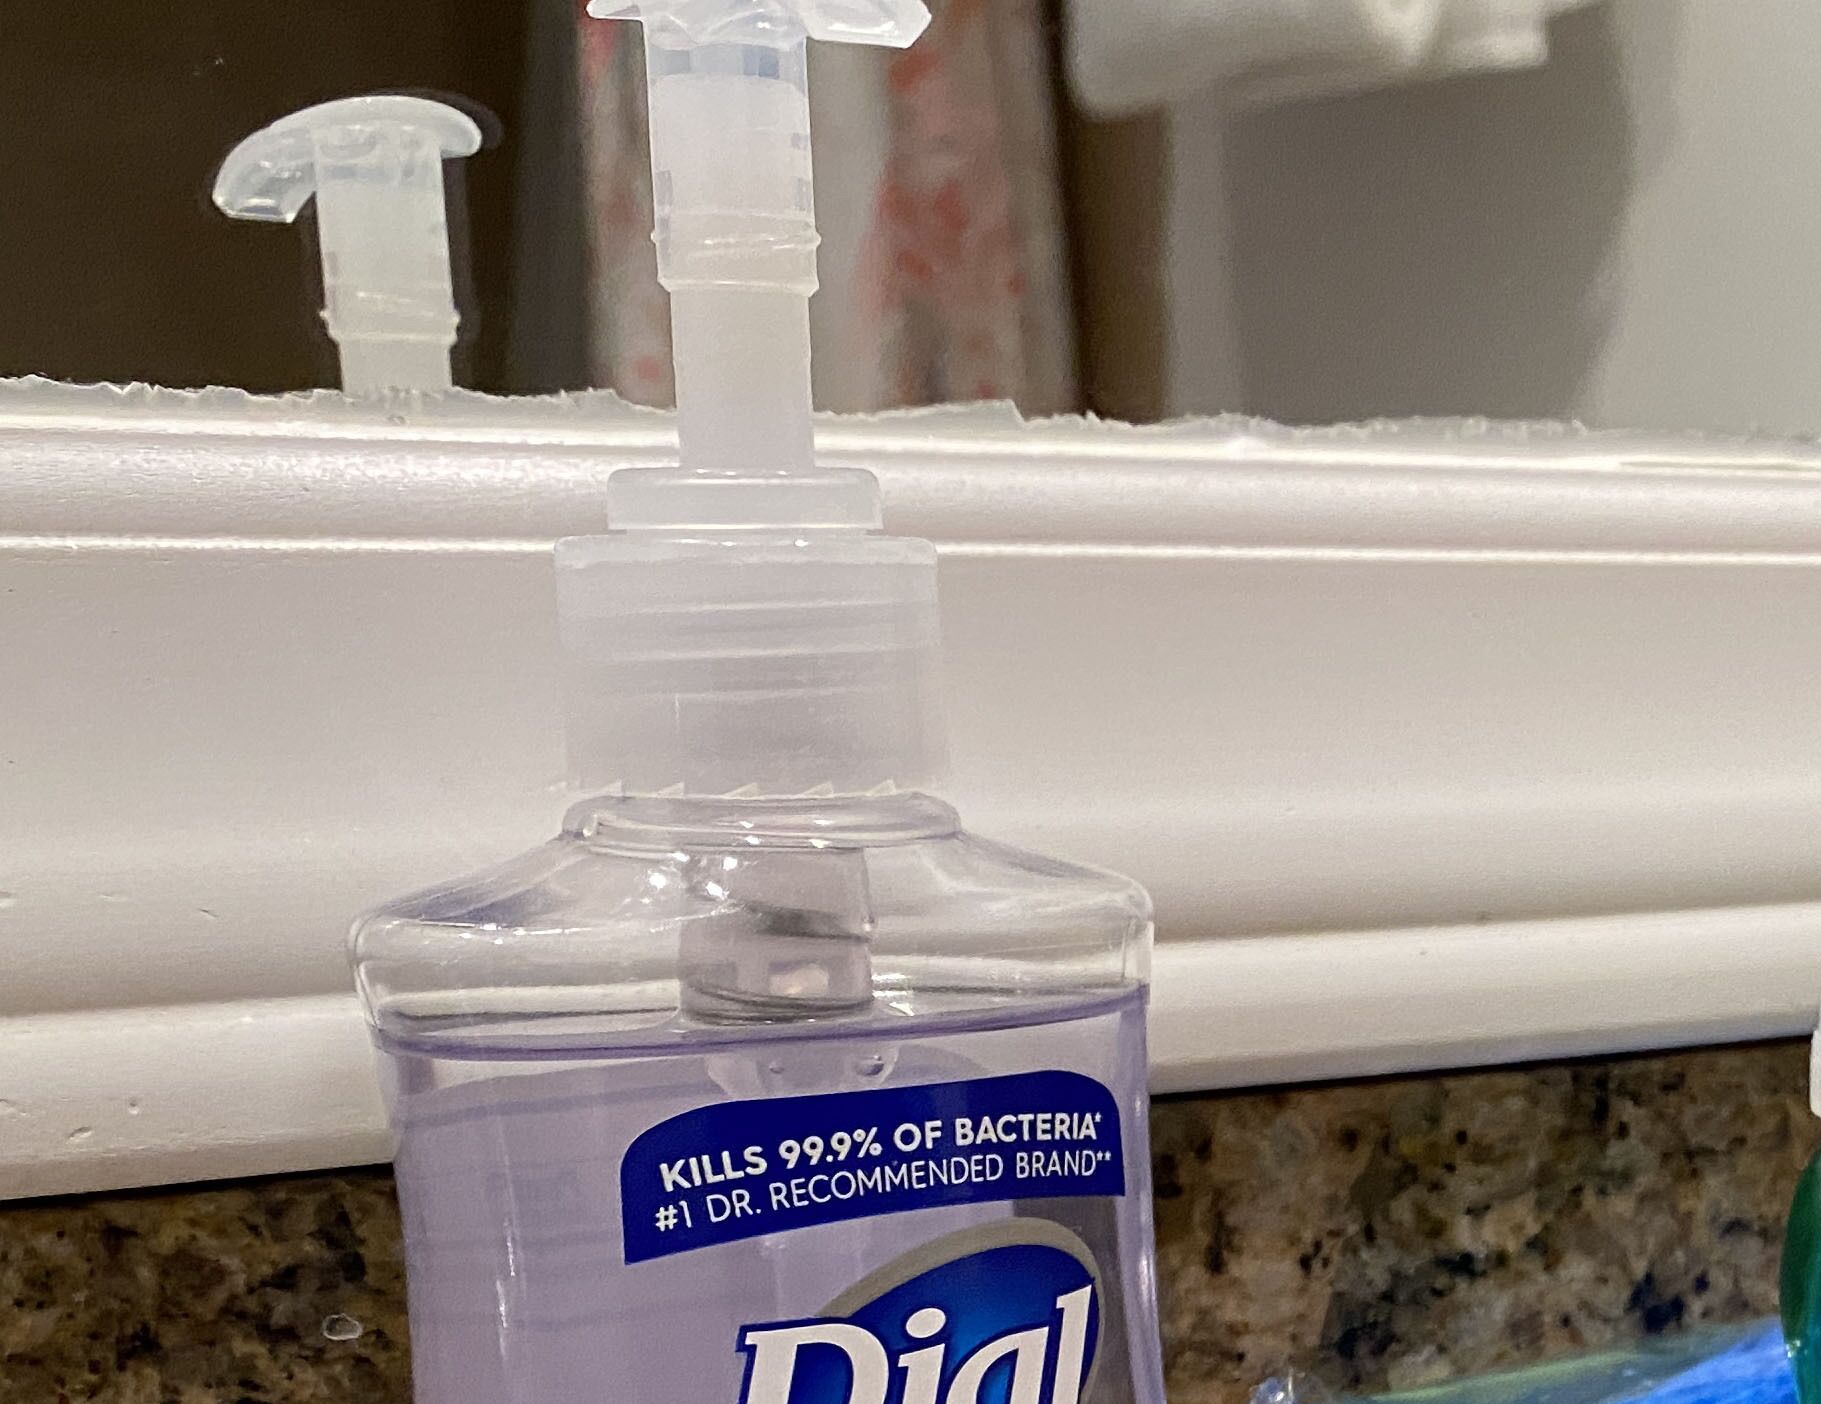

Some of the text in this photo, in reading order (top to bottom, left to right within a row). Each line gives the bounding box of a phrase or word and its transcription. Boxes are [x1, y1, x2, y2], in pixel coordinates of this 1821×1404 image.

[655, 1200, 692, 1231] #1
[706, 1189, 761, 1223] DR.
[769, 1154, 1004, 1210] RECOMMENDED
[660, 1146, 767, 1192] KILLS
[779, 1127, 883, 1169] 99.9%
[893, 1120, 942, 1152] OF
